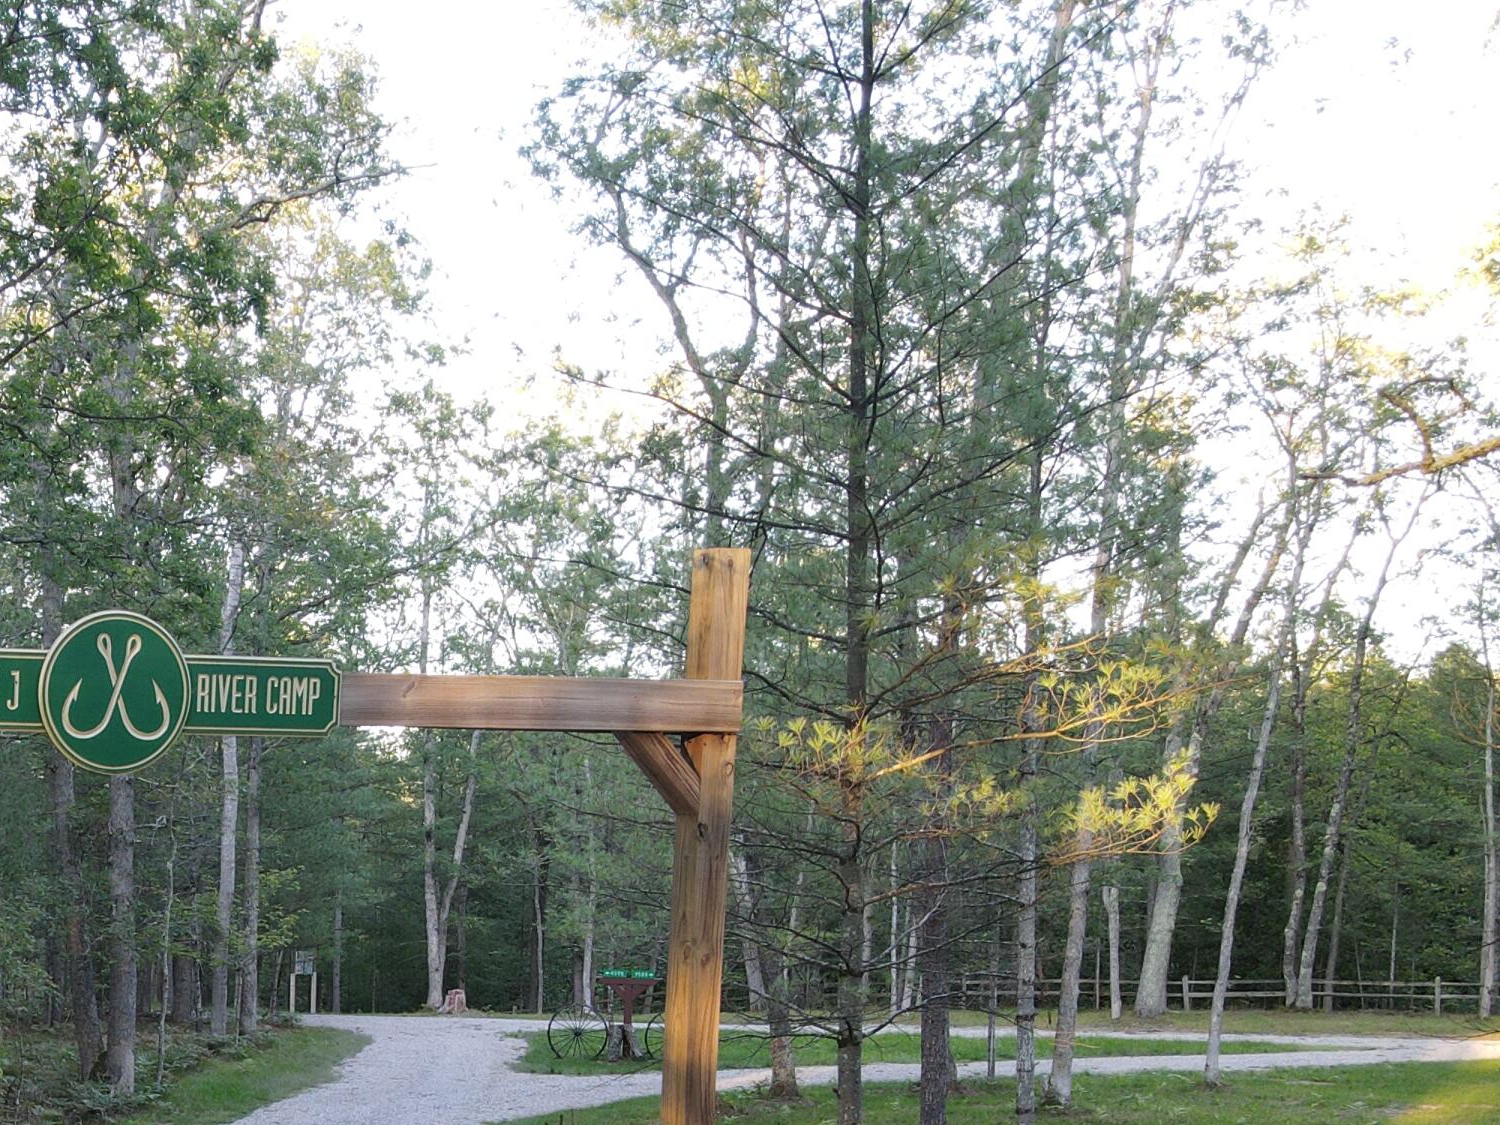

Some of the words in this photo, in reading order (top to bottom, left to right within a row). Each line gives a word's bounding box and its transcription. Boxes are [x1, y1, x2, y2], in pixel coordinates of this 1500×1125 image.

[5, 670, 20, 712] J
[195, 672, 257, 715] RIVER
[266, 675, 321, 716] CAMP
